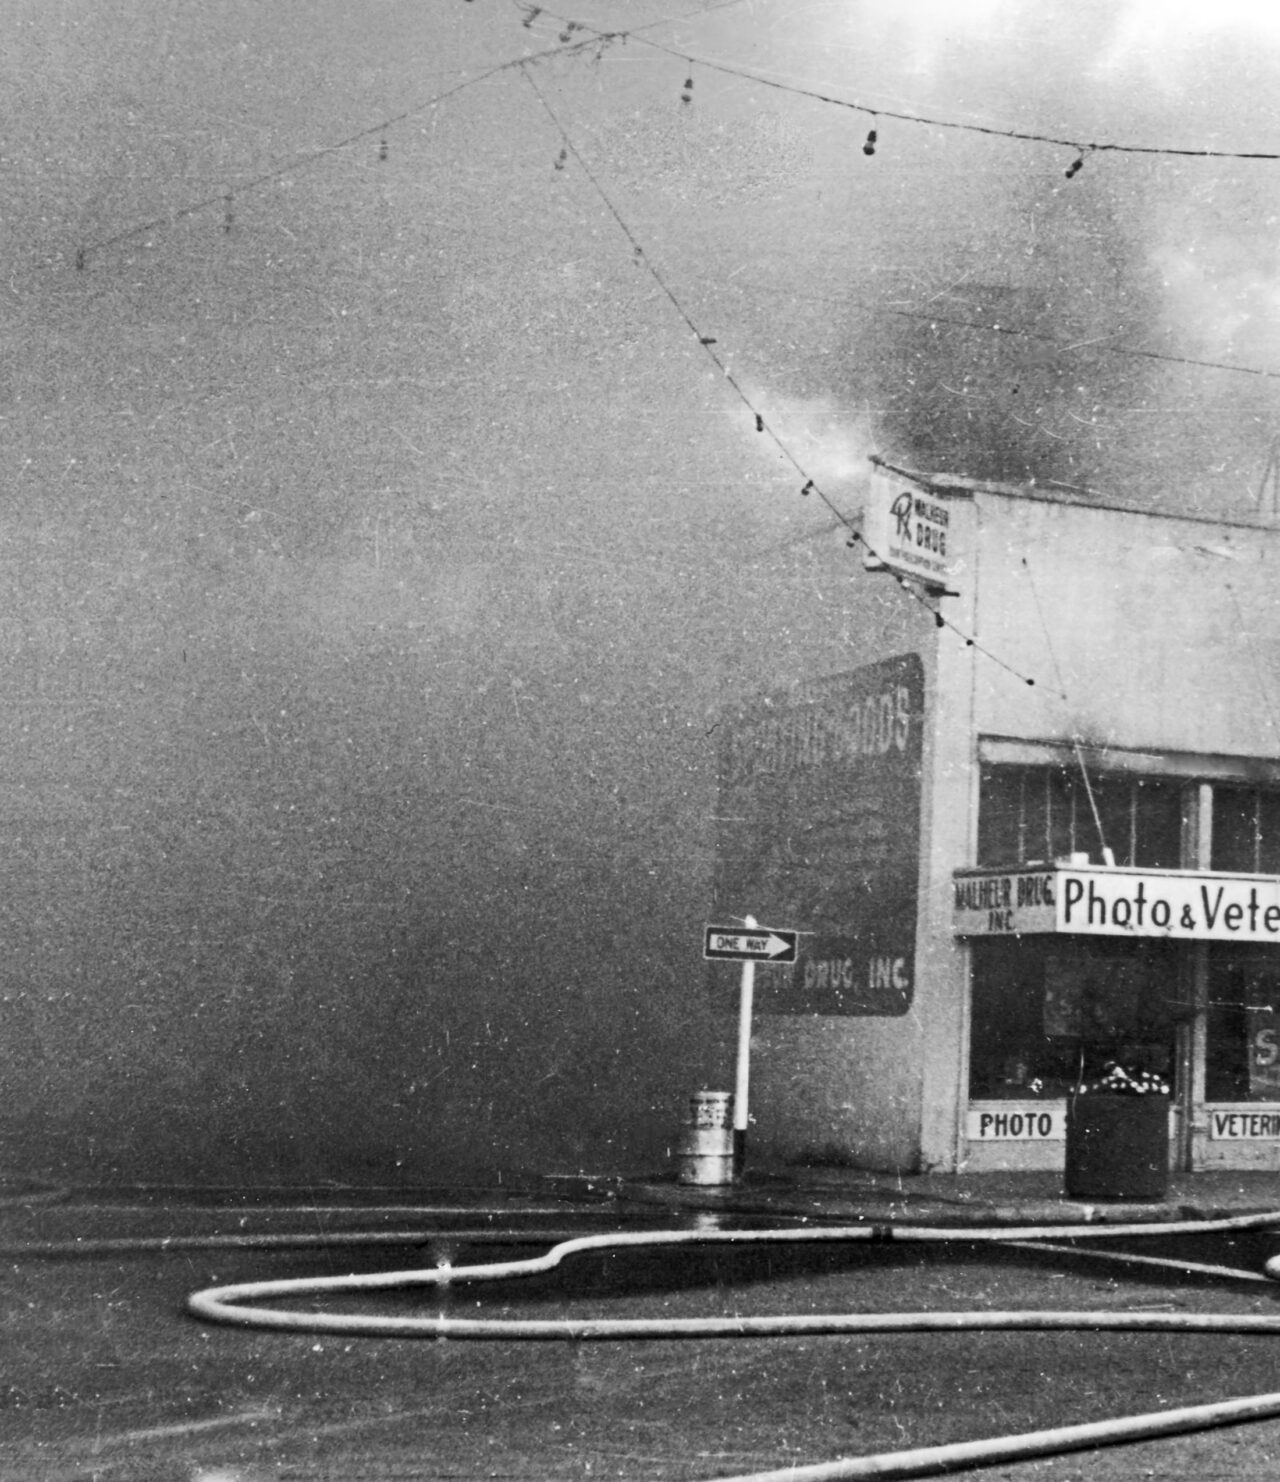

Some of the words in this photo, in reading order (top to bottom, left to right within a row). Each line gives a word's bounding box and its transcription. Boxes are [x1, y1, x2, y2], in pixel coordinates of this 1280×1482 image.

[1065, 878, 1171, 927] Photo
[1180, 904, 1196, 930] &
[716, 936, 740, 950] ONE
[746, 938, 769, 952] WAY
[980, 1113, 1052, 1137] PHOTO
